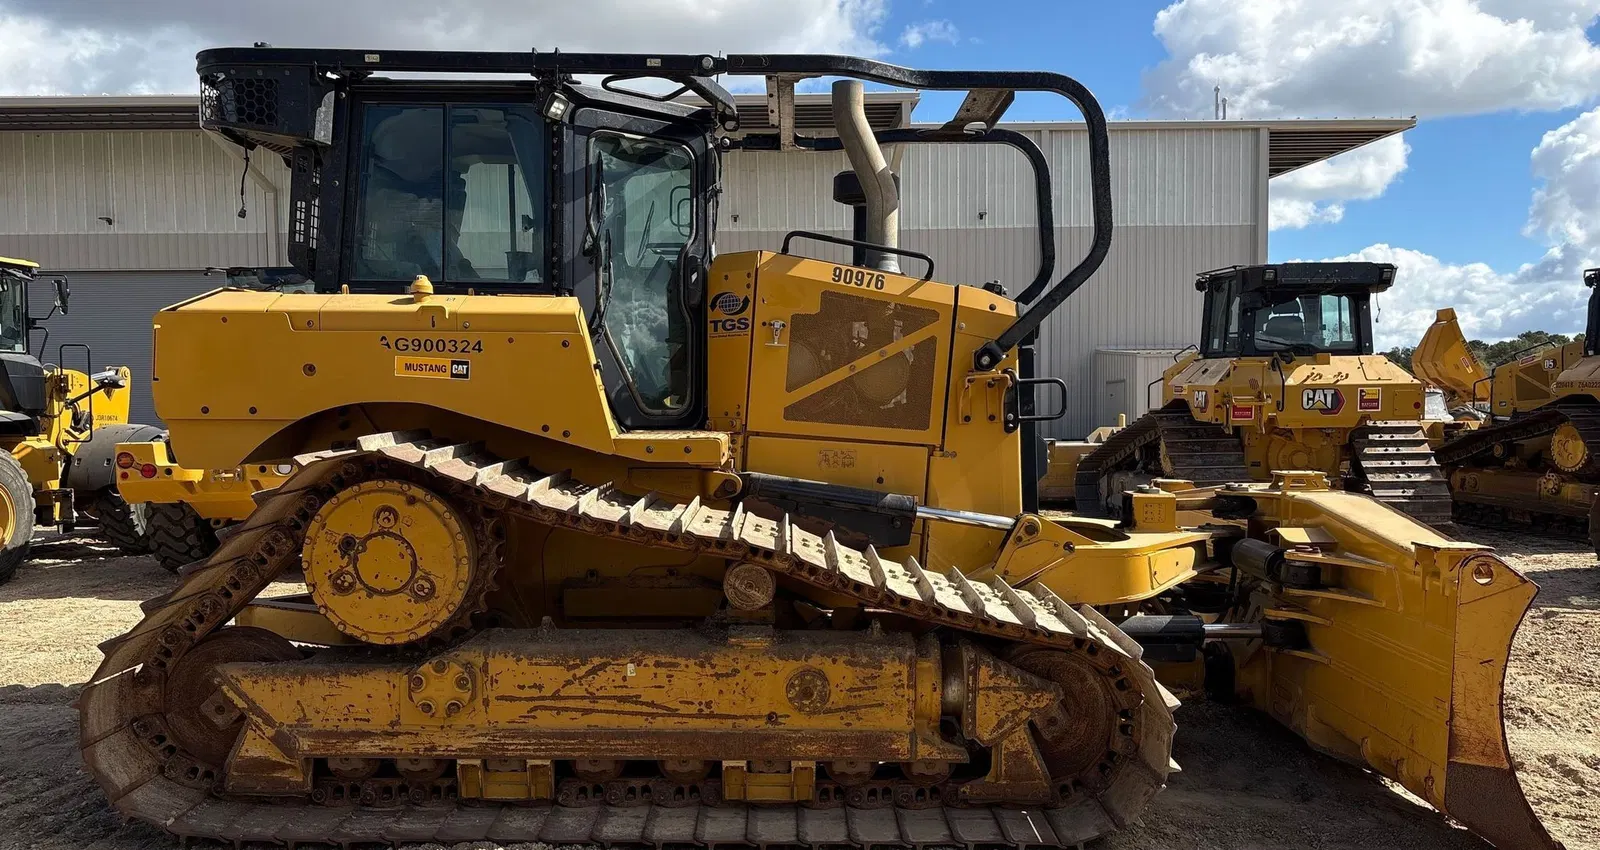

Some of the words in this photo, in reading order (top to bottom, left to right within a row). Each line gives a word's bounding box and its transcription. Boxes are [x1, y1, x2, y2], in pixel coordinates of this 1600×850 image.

[831, 266, 886, 290] 90976
[709, 317, 750, 332] TGS
[380, 336, 483, 353] AG900324
[404, 363, 447, 373] MUSTANG
[452, 364, 468, 374] CAT
[1194, 390, 1206, 407] CAT
[1302, 389, 1335, 409] CAT
